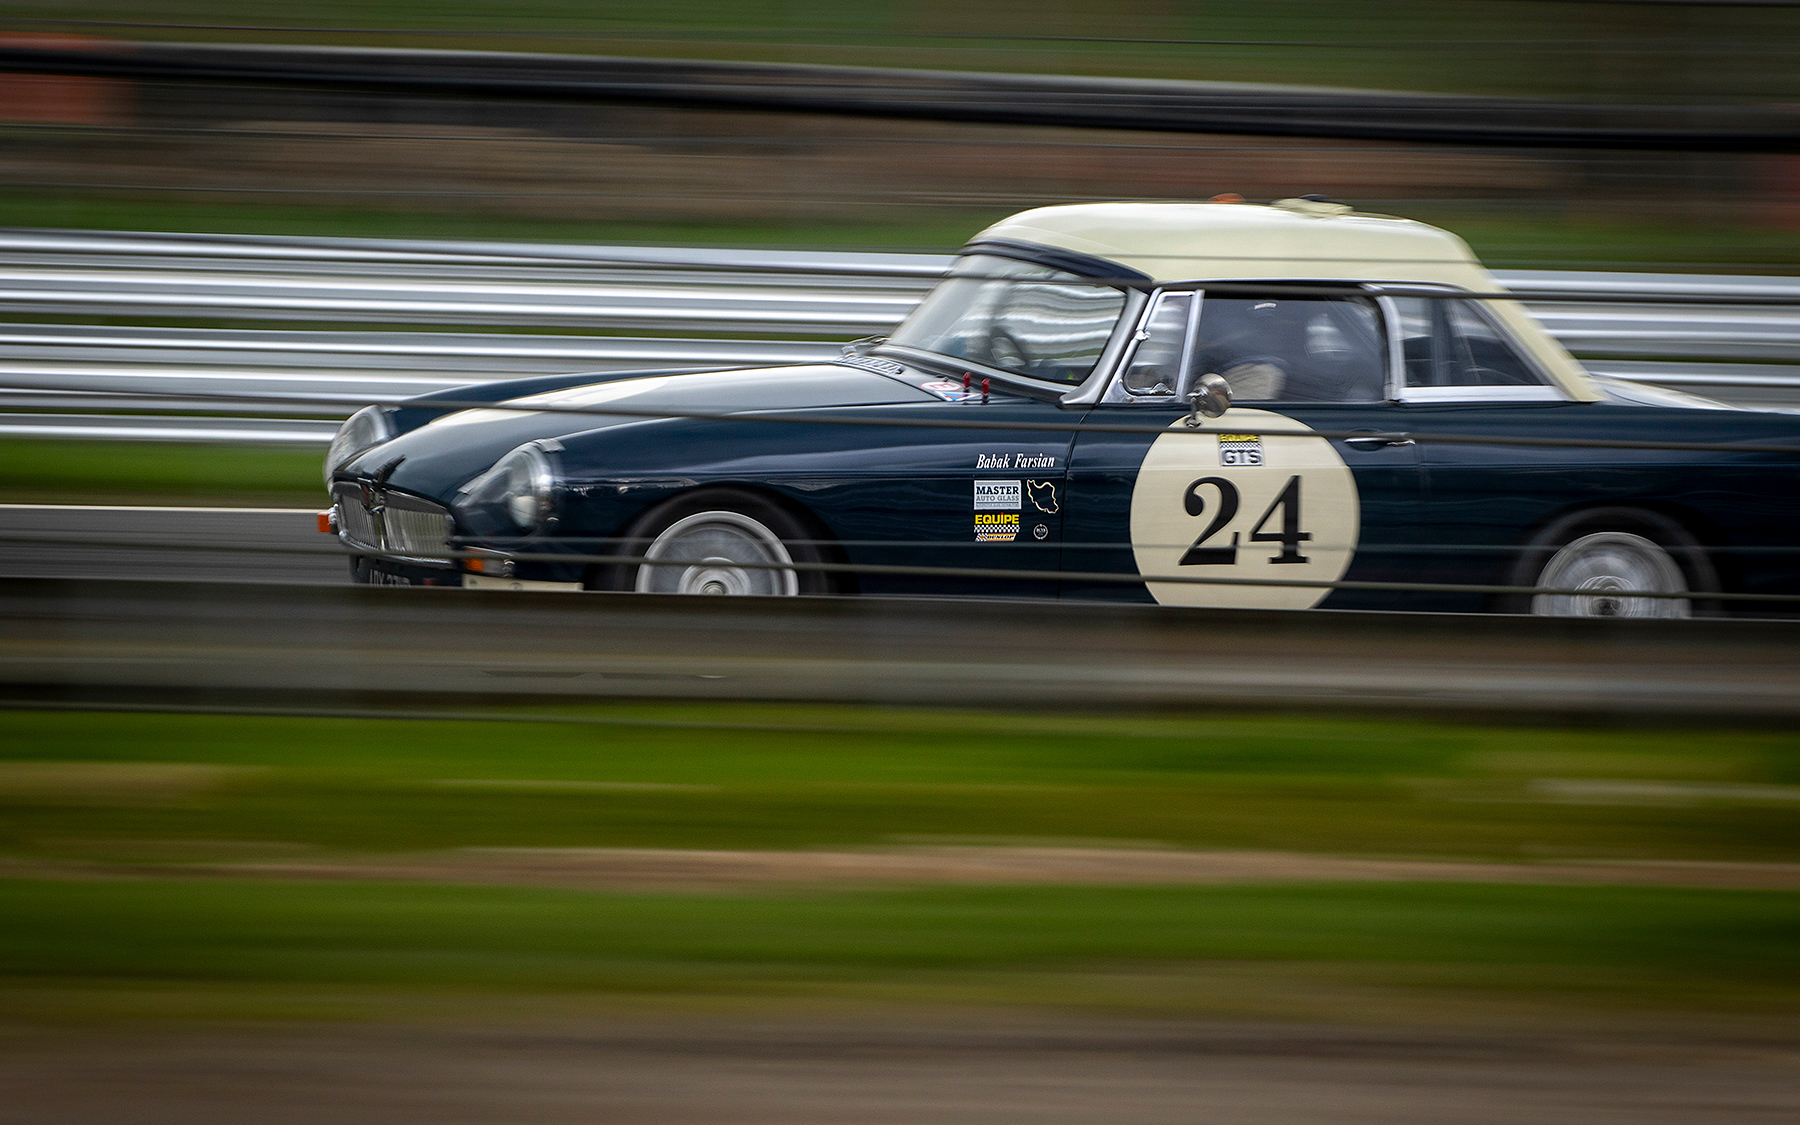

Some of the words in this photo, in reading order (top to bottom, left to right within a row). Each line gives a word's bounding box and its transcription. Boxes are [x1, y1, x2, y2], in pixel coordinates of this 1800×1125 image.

[976, 453, 1010, 469] Babak
[1014, 453, 1055, 469] Farsian
[1222, 450, 1261, 464] GTS
[976, 486, 1019, 495] MASTER
[1179, 474, 1313, 565] 24
